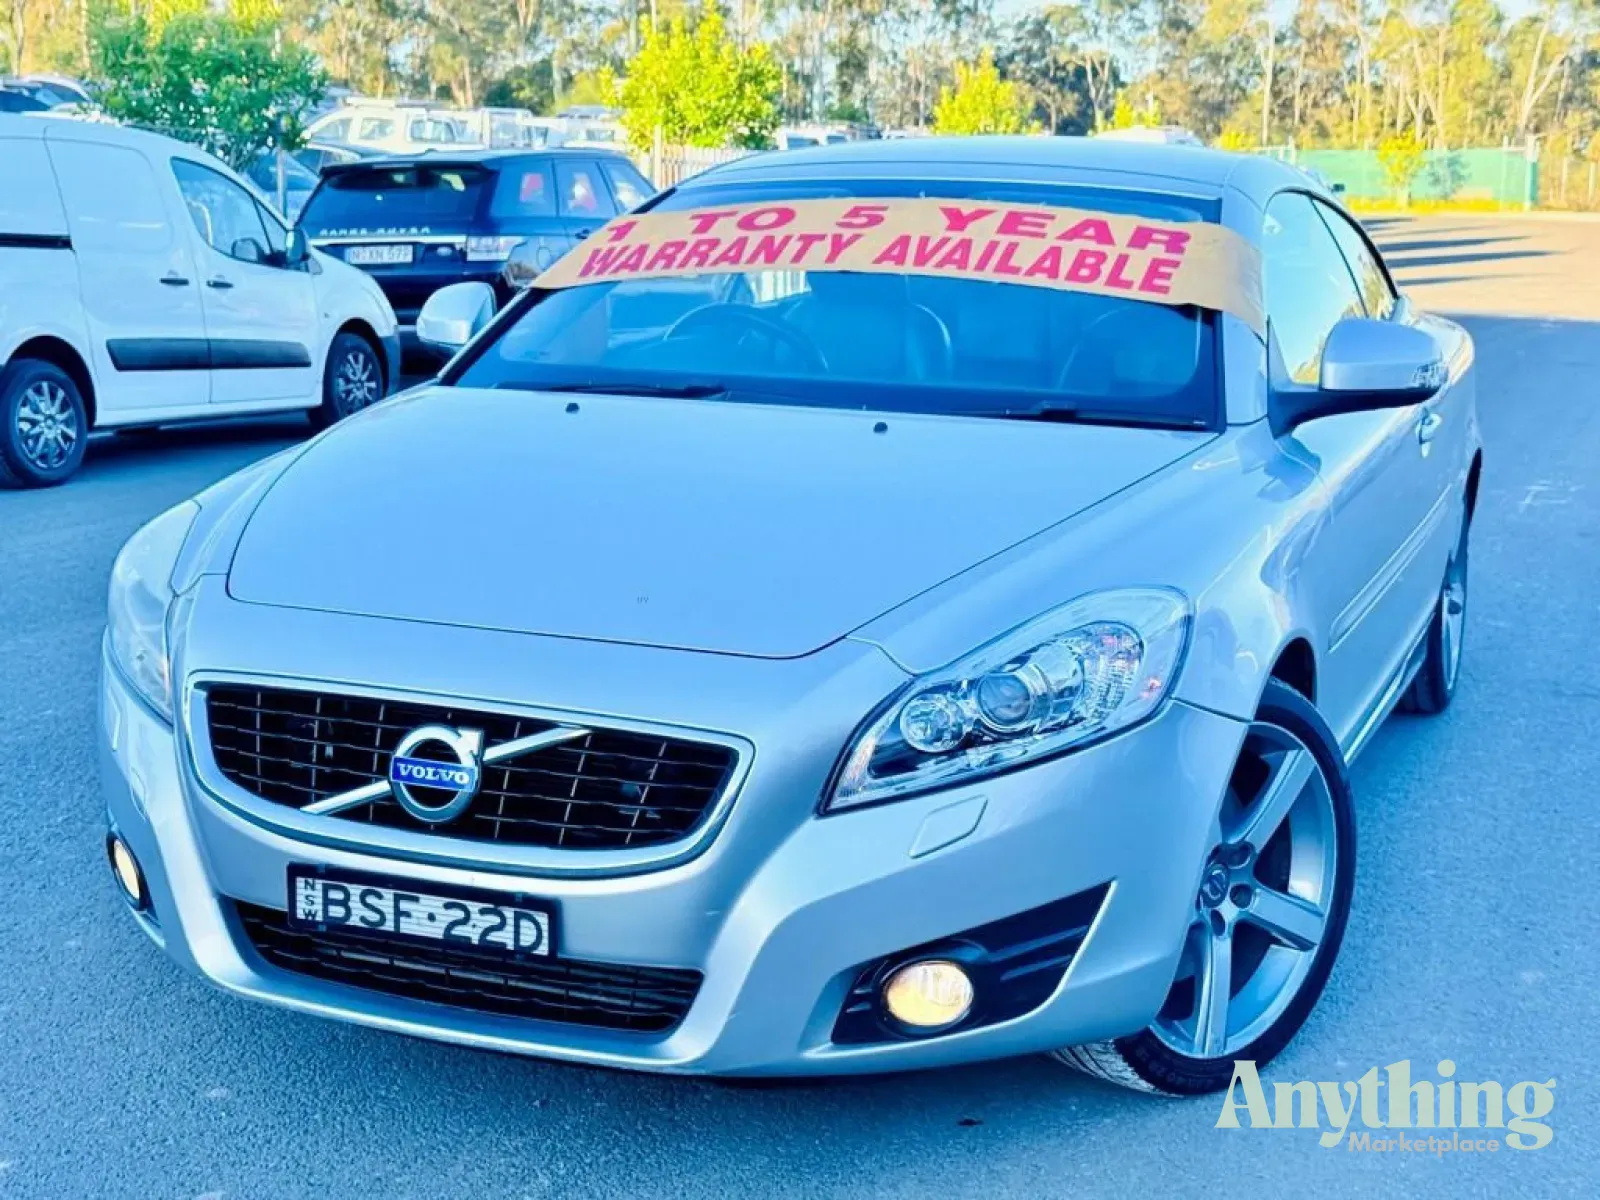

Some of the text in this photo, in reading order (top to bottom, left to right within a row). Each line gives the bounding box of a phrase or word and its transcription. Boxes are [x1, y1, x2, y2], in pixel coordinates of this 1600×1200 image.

[606, 205, 1192, 254] 1 TO 5 YEAR
[578, 233, 1181, 295] WARRANTY AVAILABLE
[397, 763, 470, 784] VOLVO
